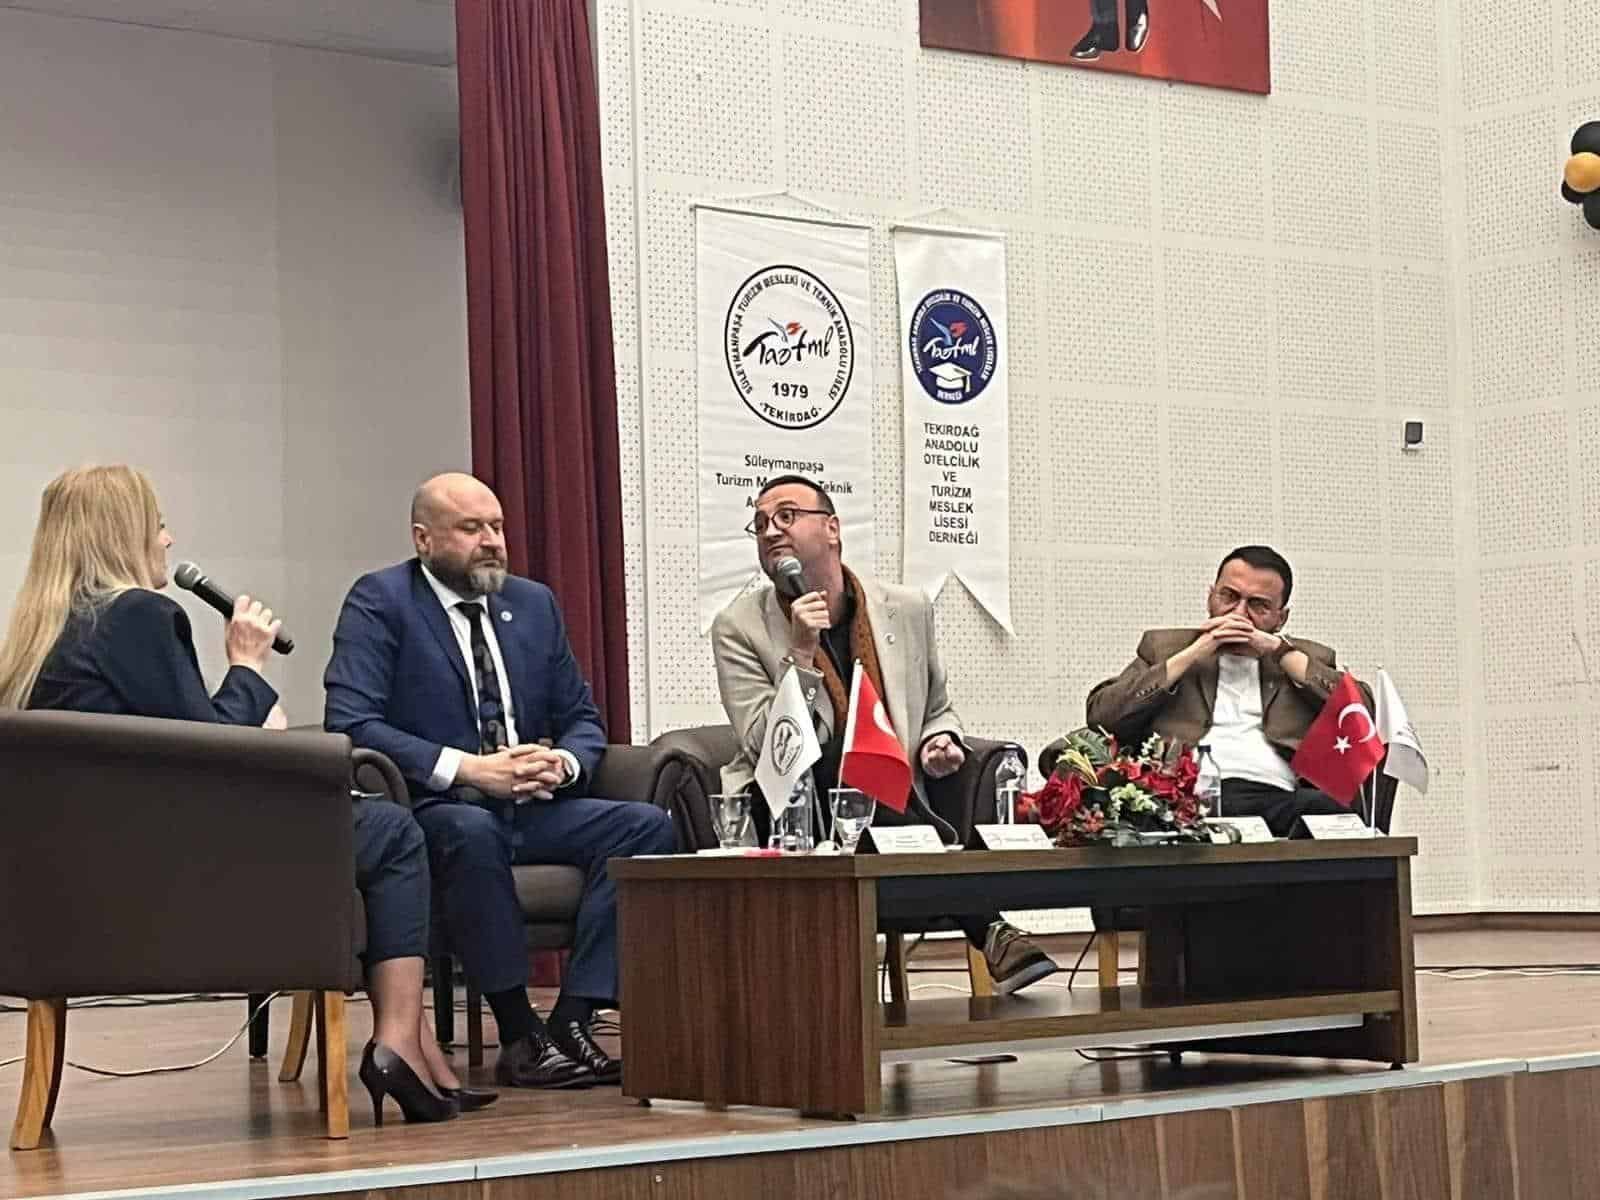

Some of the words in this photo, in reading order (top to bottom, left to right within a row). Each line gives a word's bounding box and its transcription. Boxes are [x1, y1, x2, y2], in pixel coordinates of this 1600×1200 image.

[729, 315, 753, 394] SÜLEYMANPAŞA
[800, 279, 811, 291] VE
[812, 286, 838, 319] TEKNİK
[833, 320, 848, 371] ANADOLU
[772, 382, 809, 398] 1979
[925, 439, 978, 453] ANADOLU
[744, 454, 824, 474] Süleymanpaşa
[924, 453, 980, 468] OTELCİLİK
[716, 473, 753, 487] Turizm
[942, 472, 957, 482] VE
[931, 485, 972, 498] TURİZM
[929, 501, 974, 514] MESLEK
[934, 515, 968, 529] LİSESİ
[929, 530, 978, 544] DERNEĞİ
